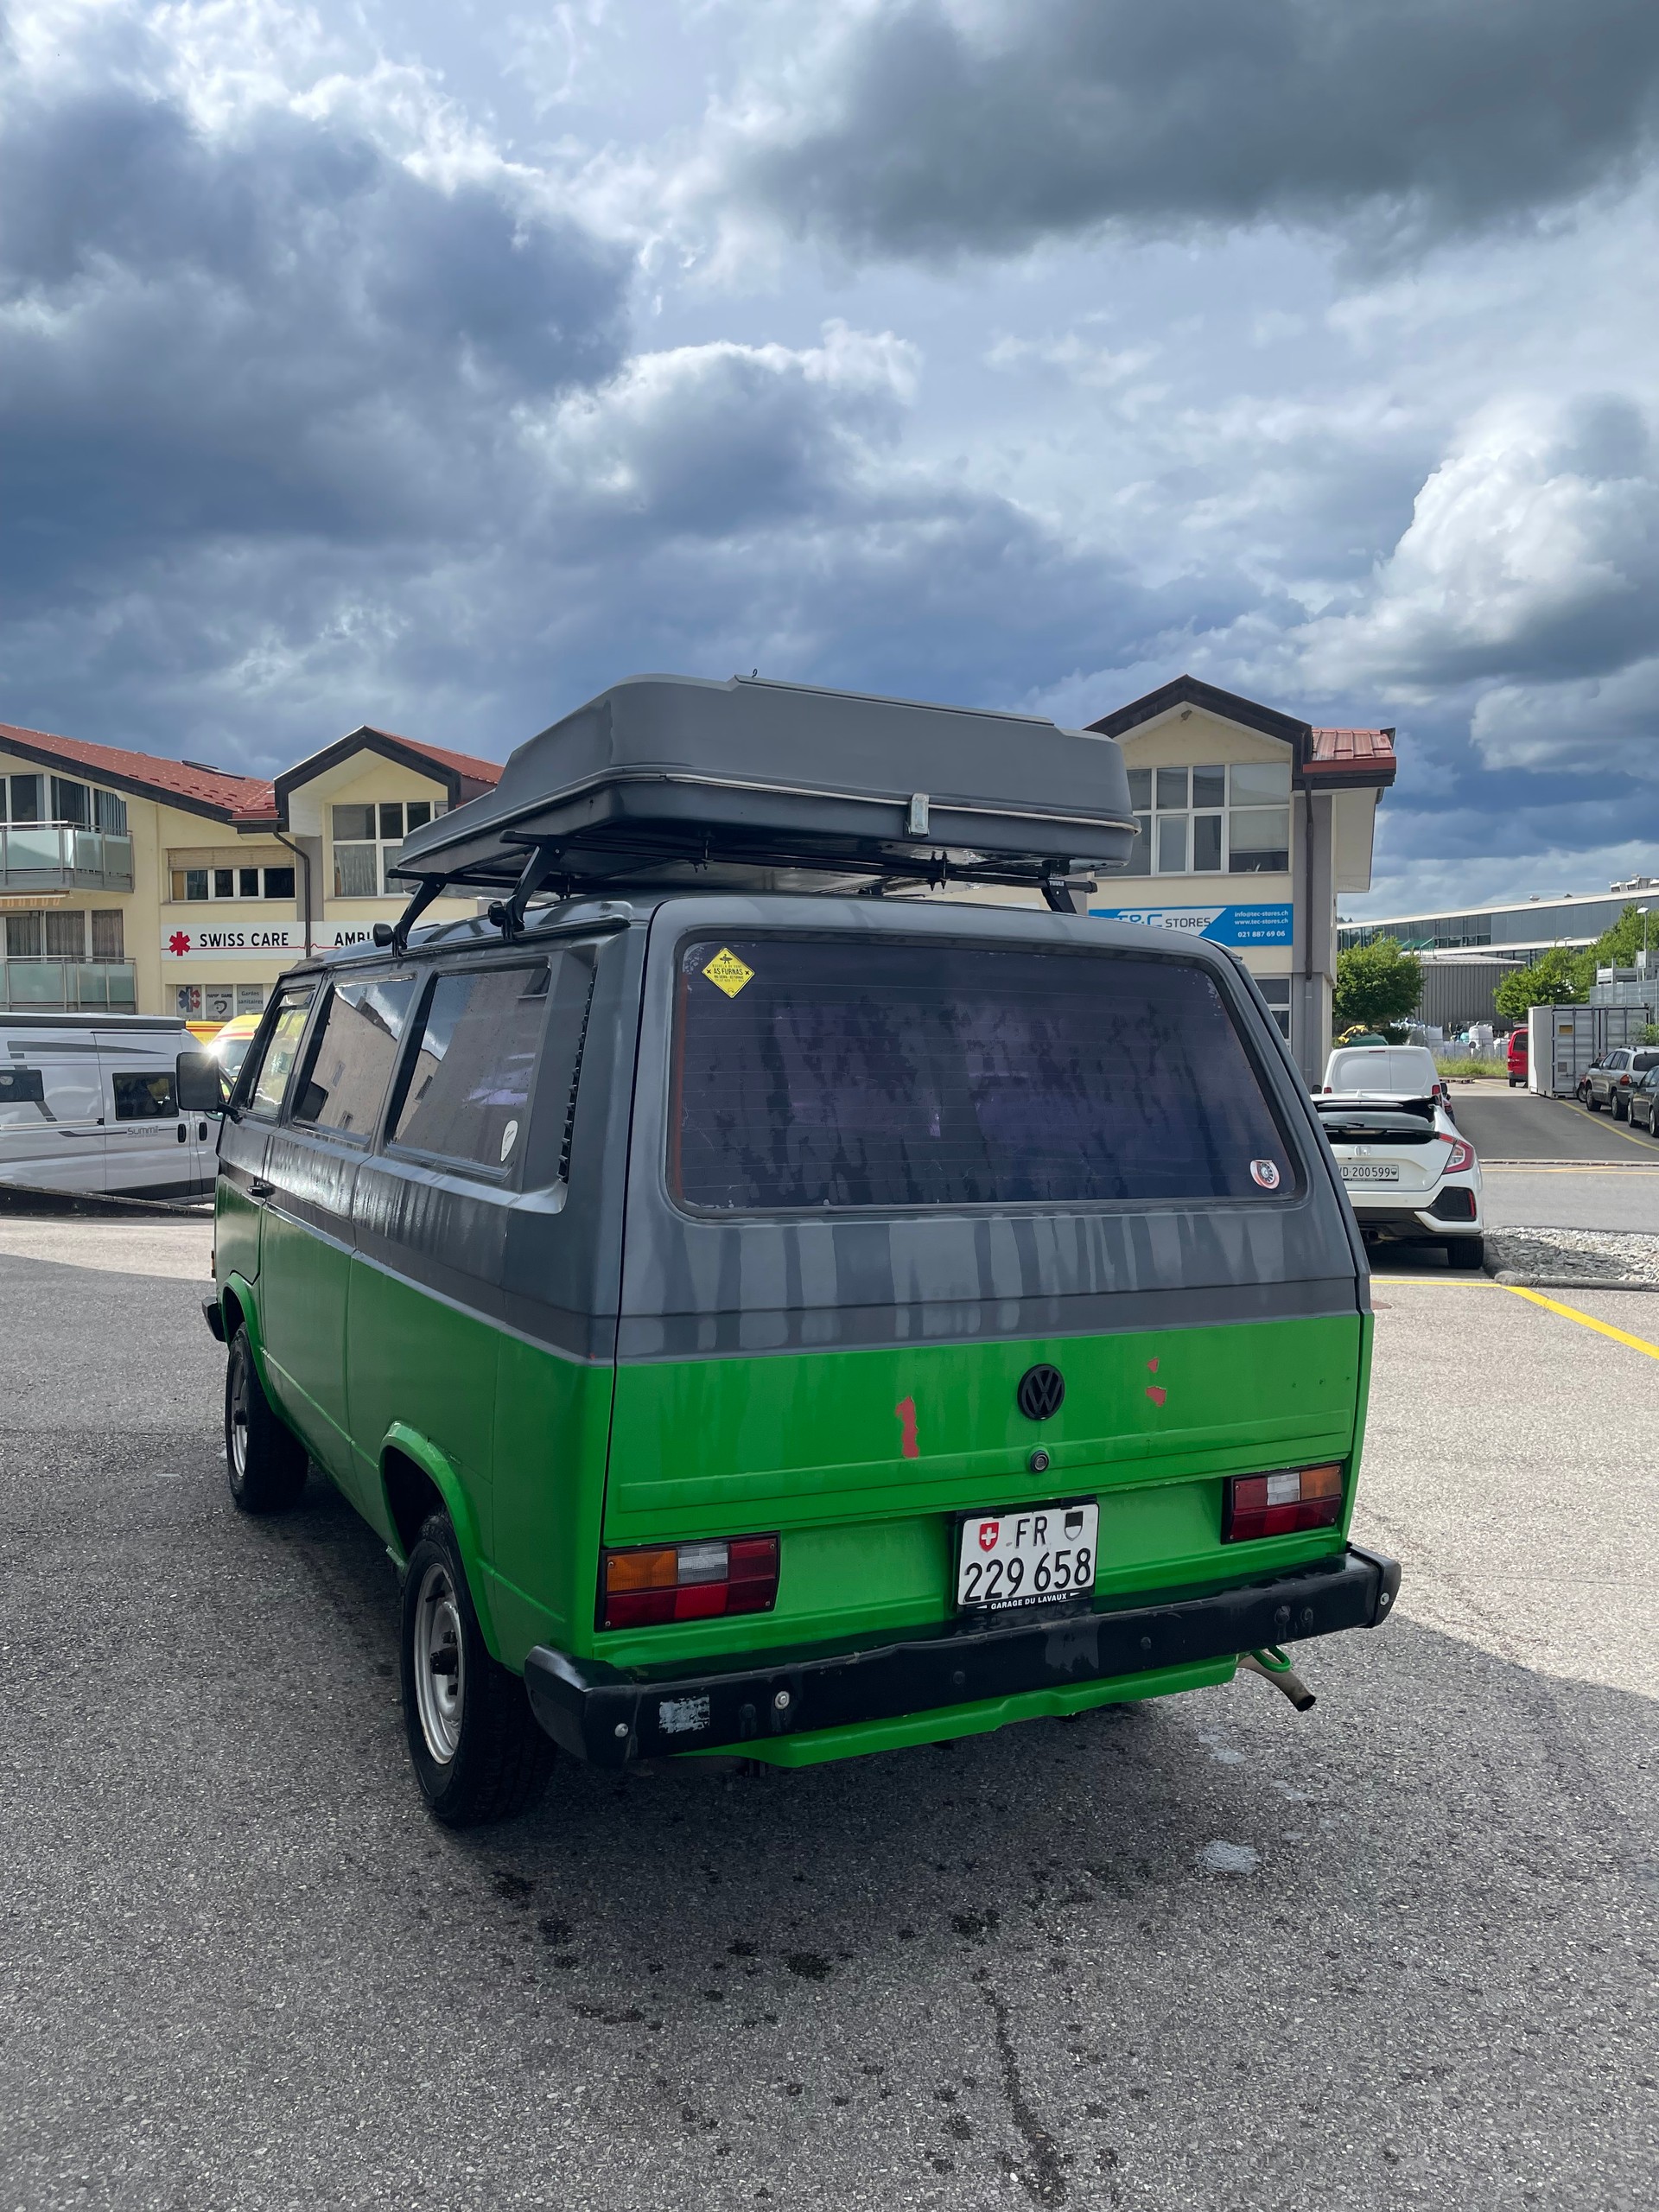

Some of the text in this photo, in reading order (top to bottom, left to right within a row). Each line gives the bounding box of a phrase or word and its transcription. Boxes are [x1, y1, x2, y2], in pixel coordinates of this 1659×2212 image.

[1165, 918, 1211, 928] STORES
[200, 932, 245, 947] SWISS
[251, 931, 289, 946] CARE
[1014, 1516, 1048, 1549] FR
[963, 1548, 1091, 1604] 229 658
[990, 1592, 1067, 1610] GARAGE DU LAVAUX
